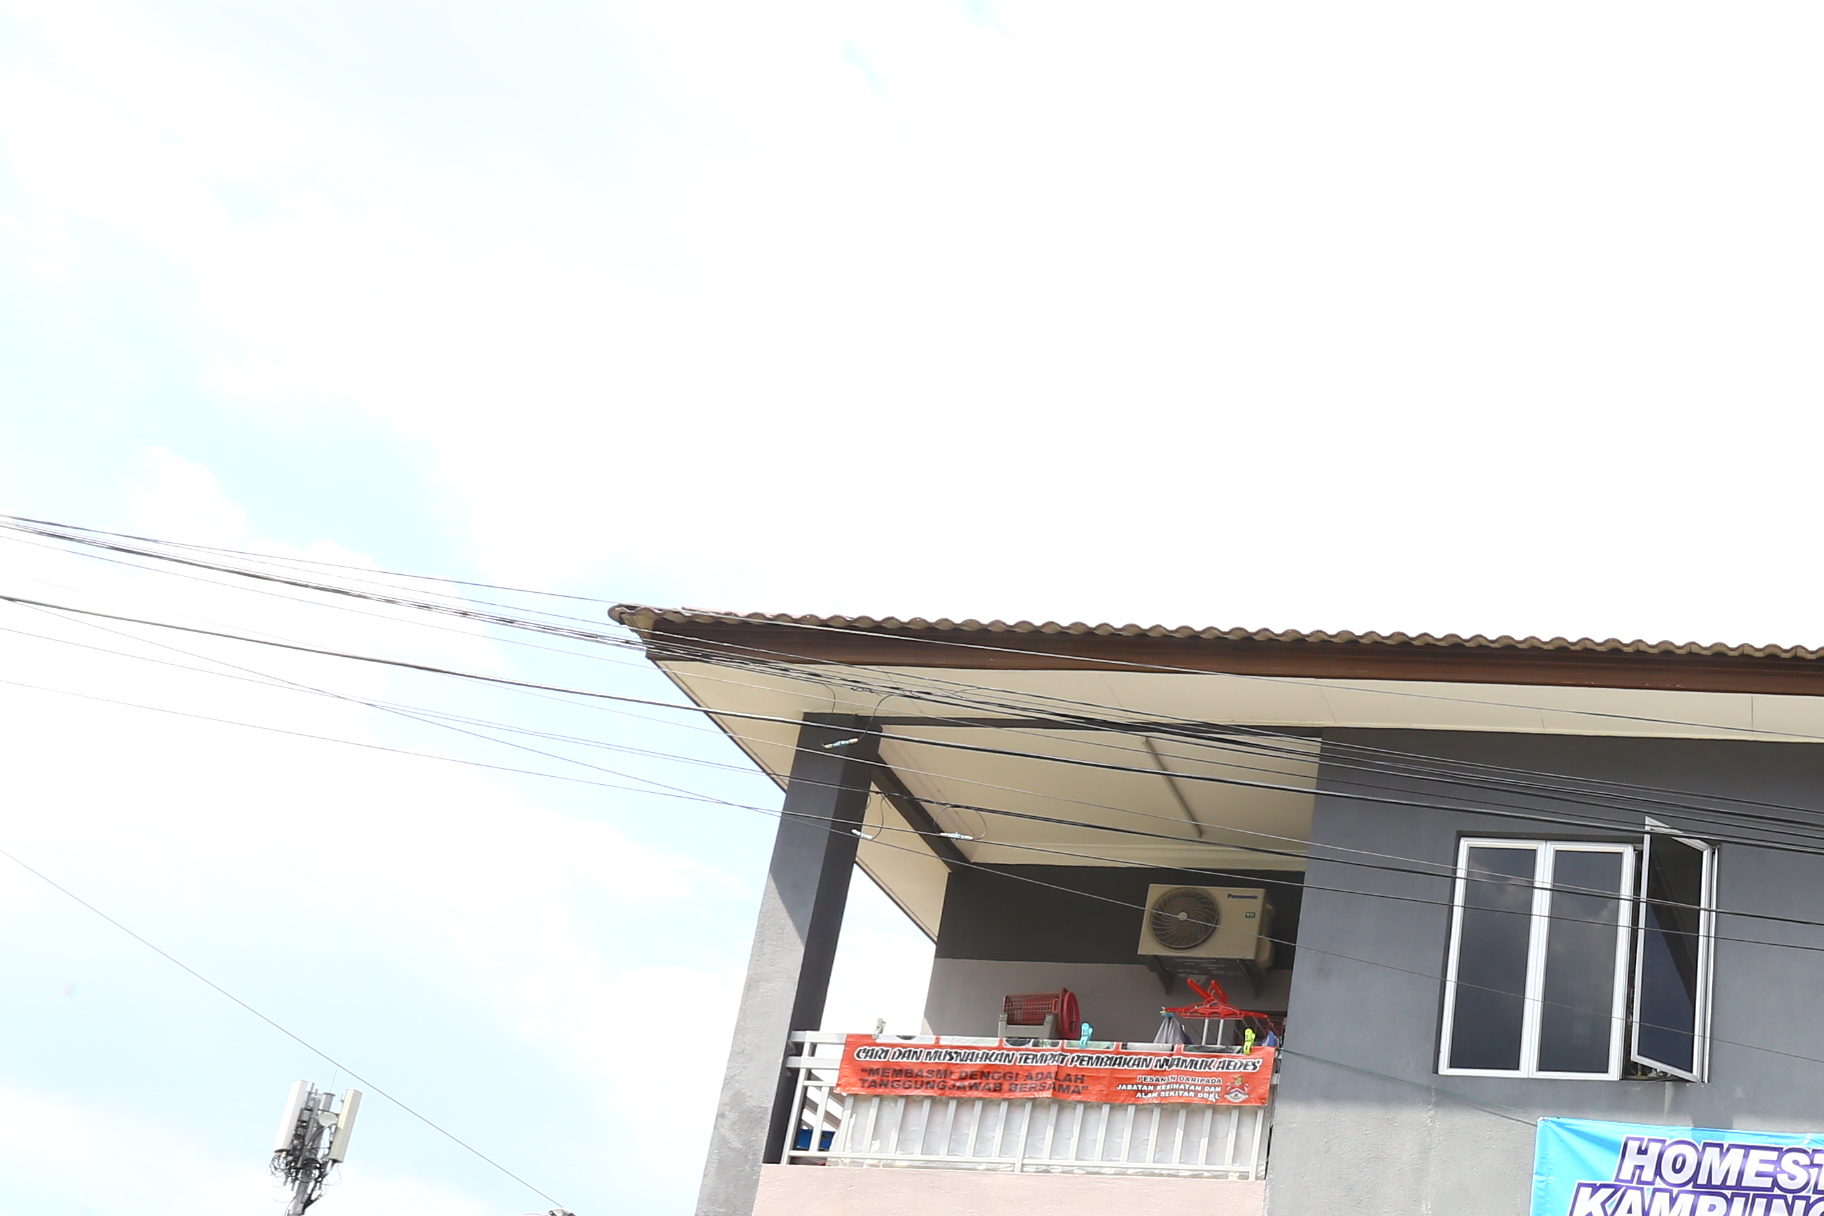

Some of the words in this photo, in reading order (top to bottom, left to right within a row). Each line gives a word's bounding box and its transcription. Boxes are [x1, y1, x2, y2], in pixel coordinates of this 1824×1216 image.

[855, 1046, 889, 1061] CARI
[891, 1047, 923, 1062] DAN
[924, 1048, 1015, 1064] MUSNAHKAN
[1017, 1052, 1069, 1066] TEMPAT
[1069, 1054, 1154, 1070] PEMBIAKAN
[1155, 1057, 1215, 1071] NYAMUK
[1215, 1058, 1262, 1072] AEDES
[959, 1069, 1019, 1081] DENGGI
[1024, 1071, 1085, 1084] ADALAH
[1179, 1076, 1222, 1084] DARIPADA
[860, 1078, 1003, 1092] TANGGUNGJAWAB
